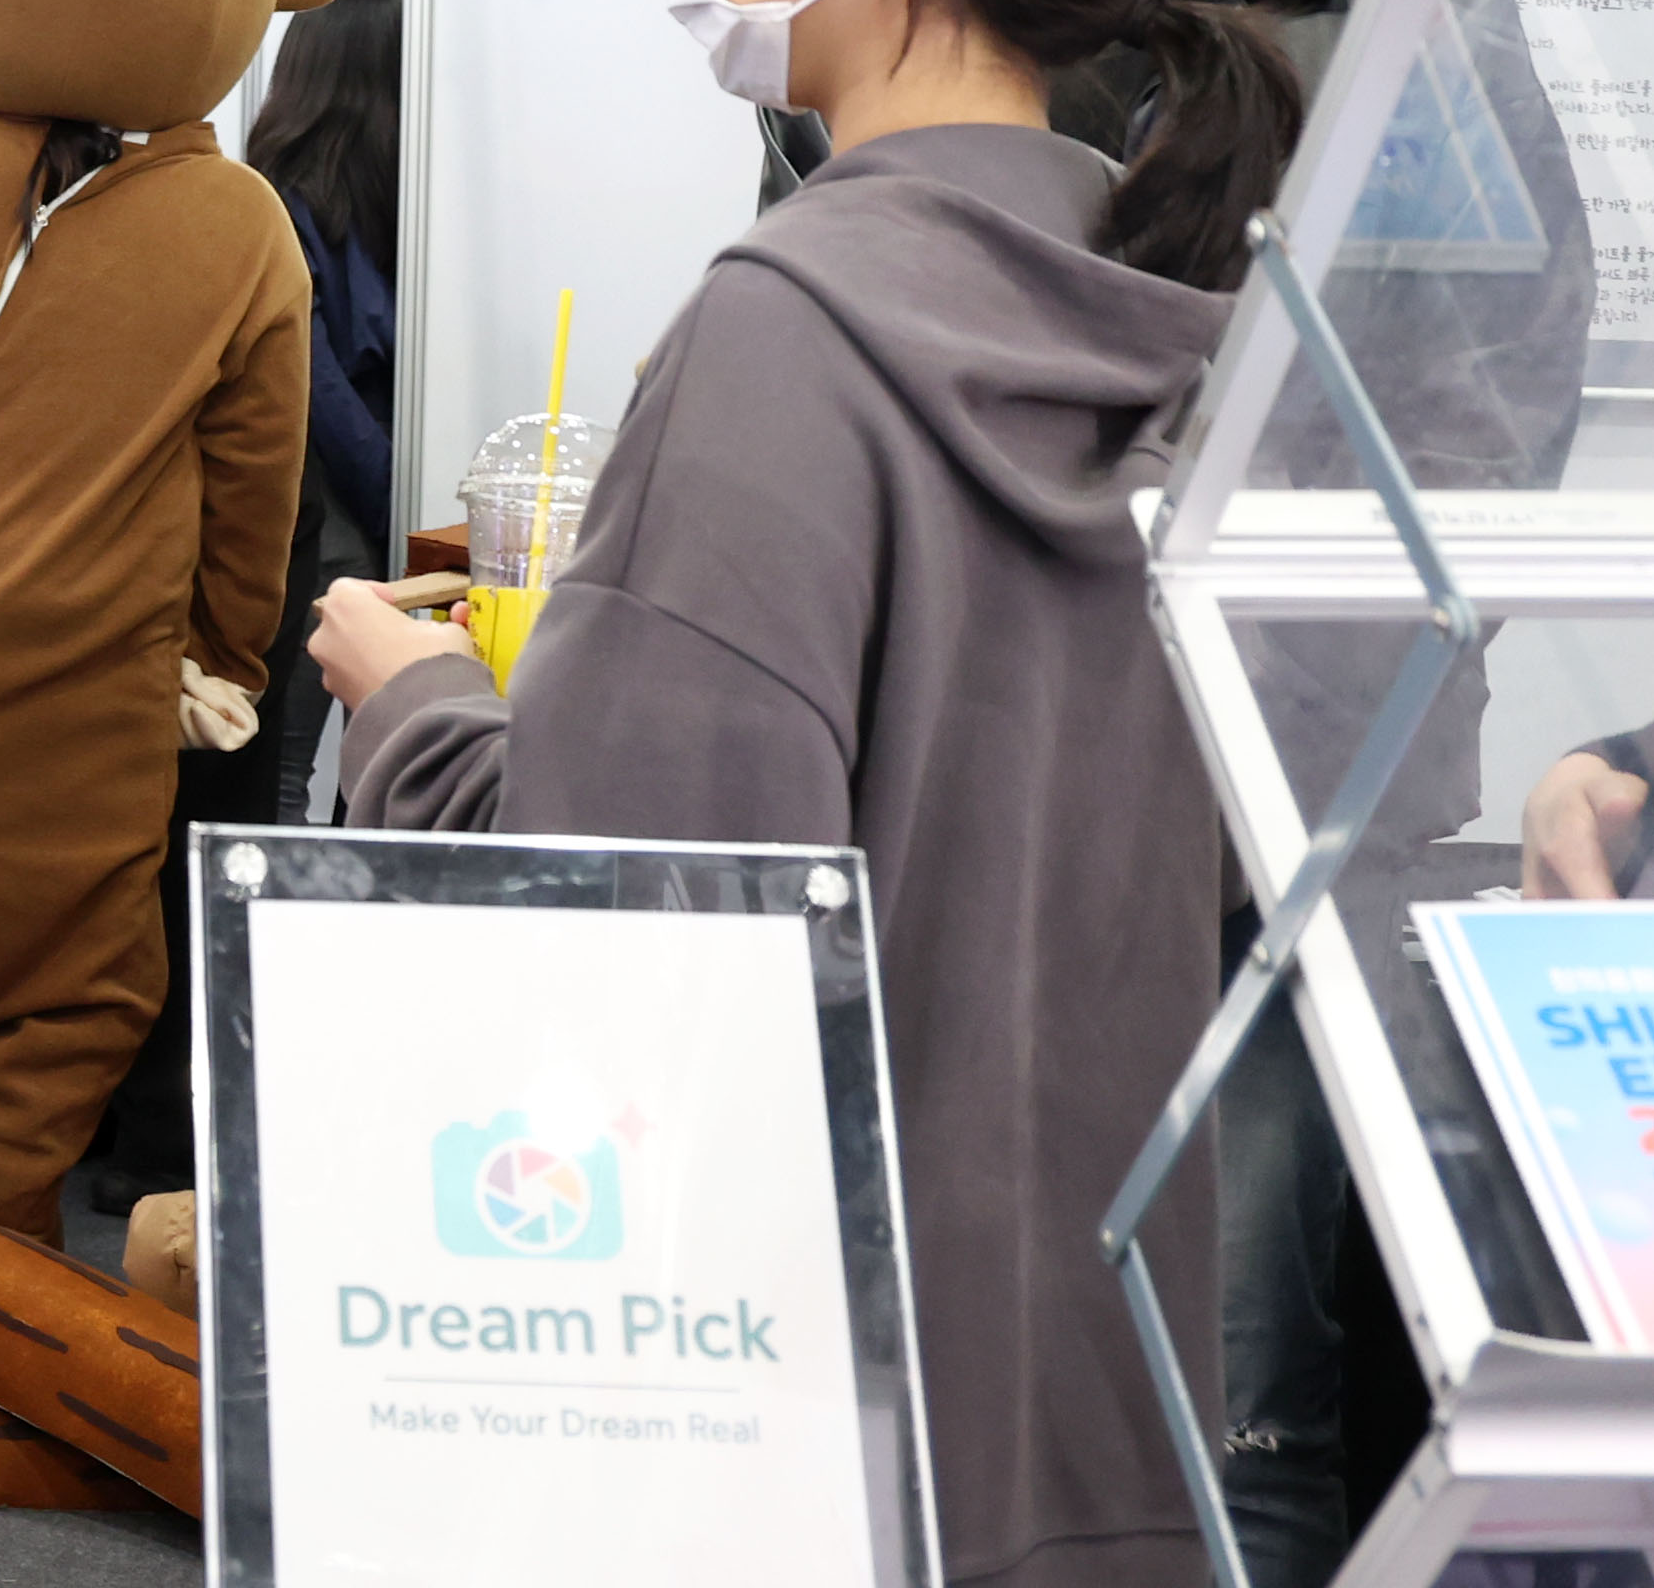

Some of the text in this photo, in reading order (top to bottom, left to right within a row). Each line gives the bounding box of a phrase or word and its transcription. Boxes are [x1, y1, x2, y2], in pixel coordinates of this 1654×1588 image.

[336, 1284, 780, 1364] Dream Pick
[369, 1402, 762, 1445] Make Your Dream Real
